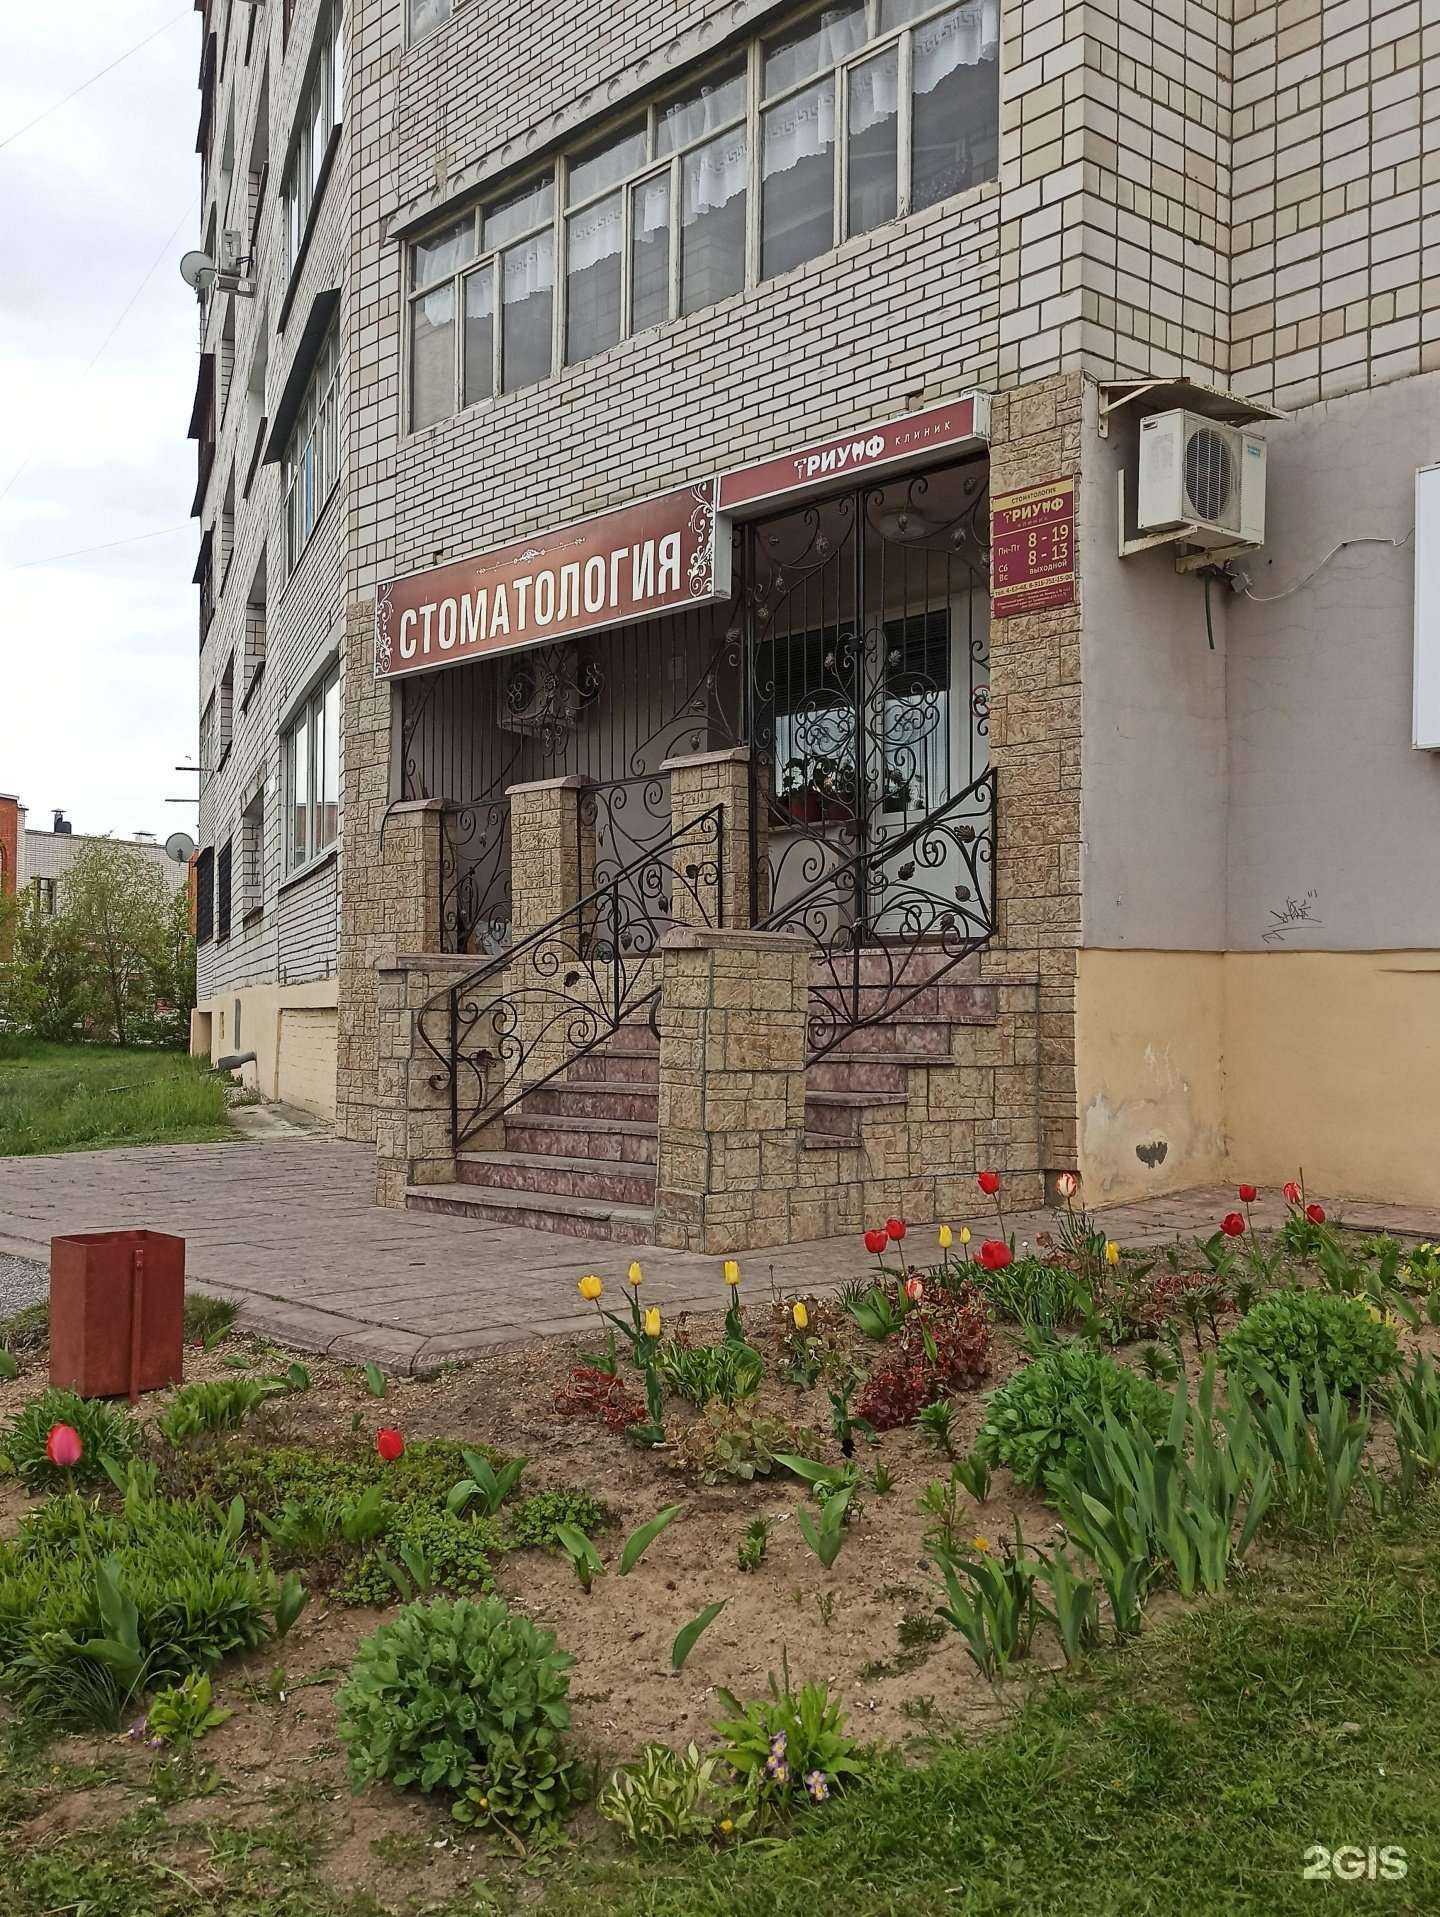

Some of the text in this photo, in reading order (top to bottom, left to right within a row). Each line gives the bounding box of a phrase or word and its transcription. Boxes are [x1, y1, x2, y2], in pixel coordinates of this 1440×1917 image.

[794, 434, 885, 479] ТРИУМФ
[1011, 487, 1057, 504] СТОМАТОЛОГИЯ
[1003, 497, 1064, 524] ТРИУМФ
[1028, 532, 1037, 548] 8
[1052, 524, 1069, 542] 19
[998, 564, 1008, 573] Сб
[1028, 550, 1037, 566] 8
[1051, 542, 1068, 561] 13
[400, 531, 681, 660] СТОМАТОЛОГИЯ
